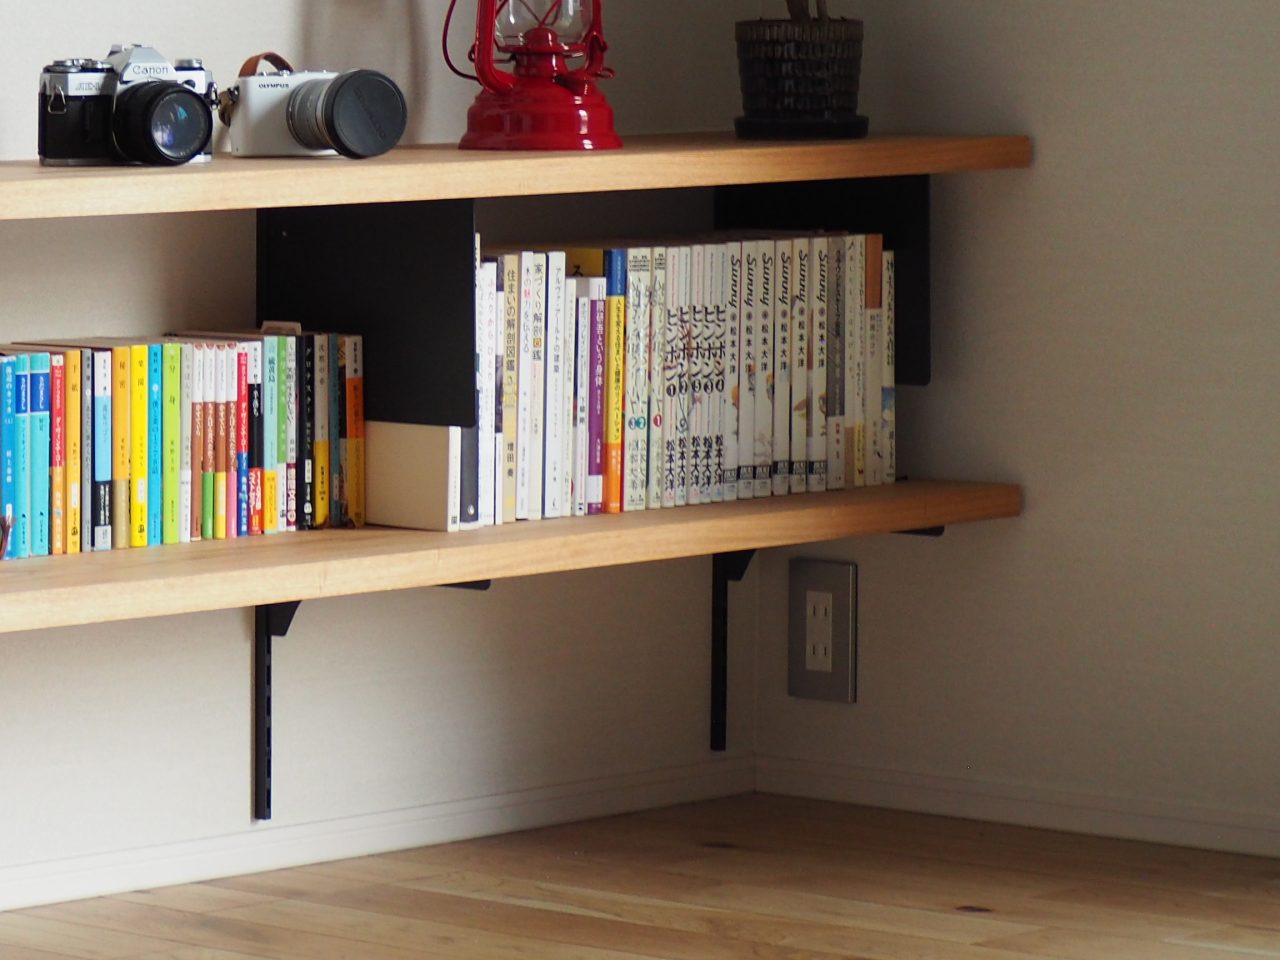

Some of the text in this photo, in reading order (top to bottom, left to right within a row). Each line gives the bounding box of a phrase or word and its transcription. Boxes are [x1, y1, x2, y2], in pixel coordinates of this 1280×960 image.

[132, 65, 169, 75] Canon
[729, 254, 740, 308] Sunny
[744, 253, 756, 308] Sunny
[760, 252, 772, 306] Sunny
[779, 252, 791, 305] Sunny
[796, 249, 808, 303] Sunny
[817, 249, 828, 303] Sunny
[506, 270, 516, 371] 住まいの解剖図鑑
